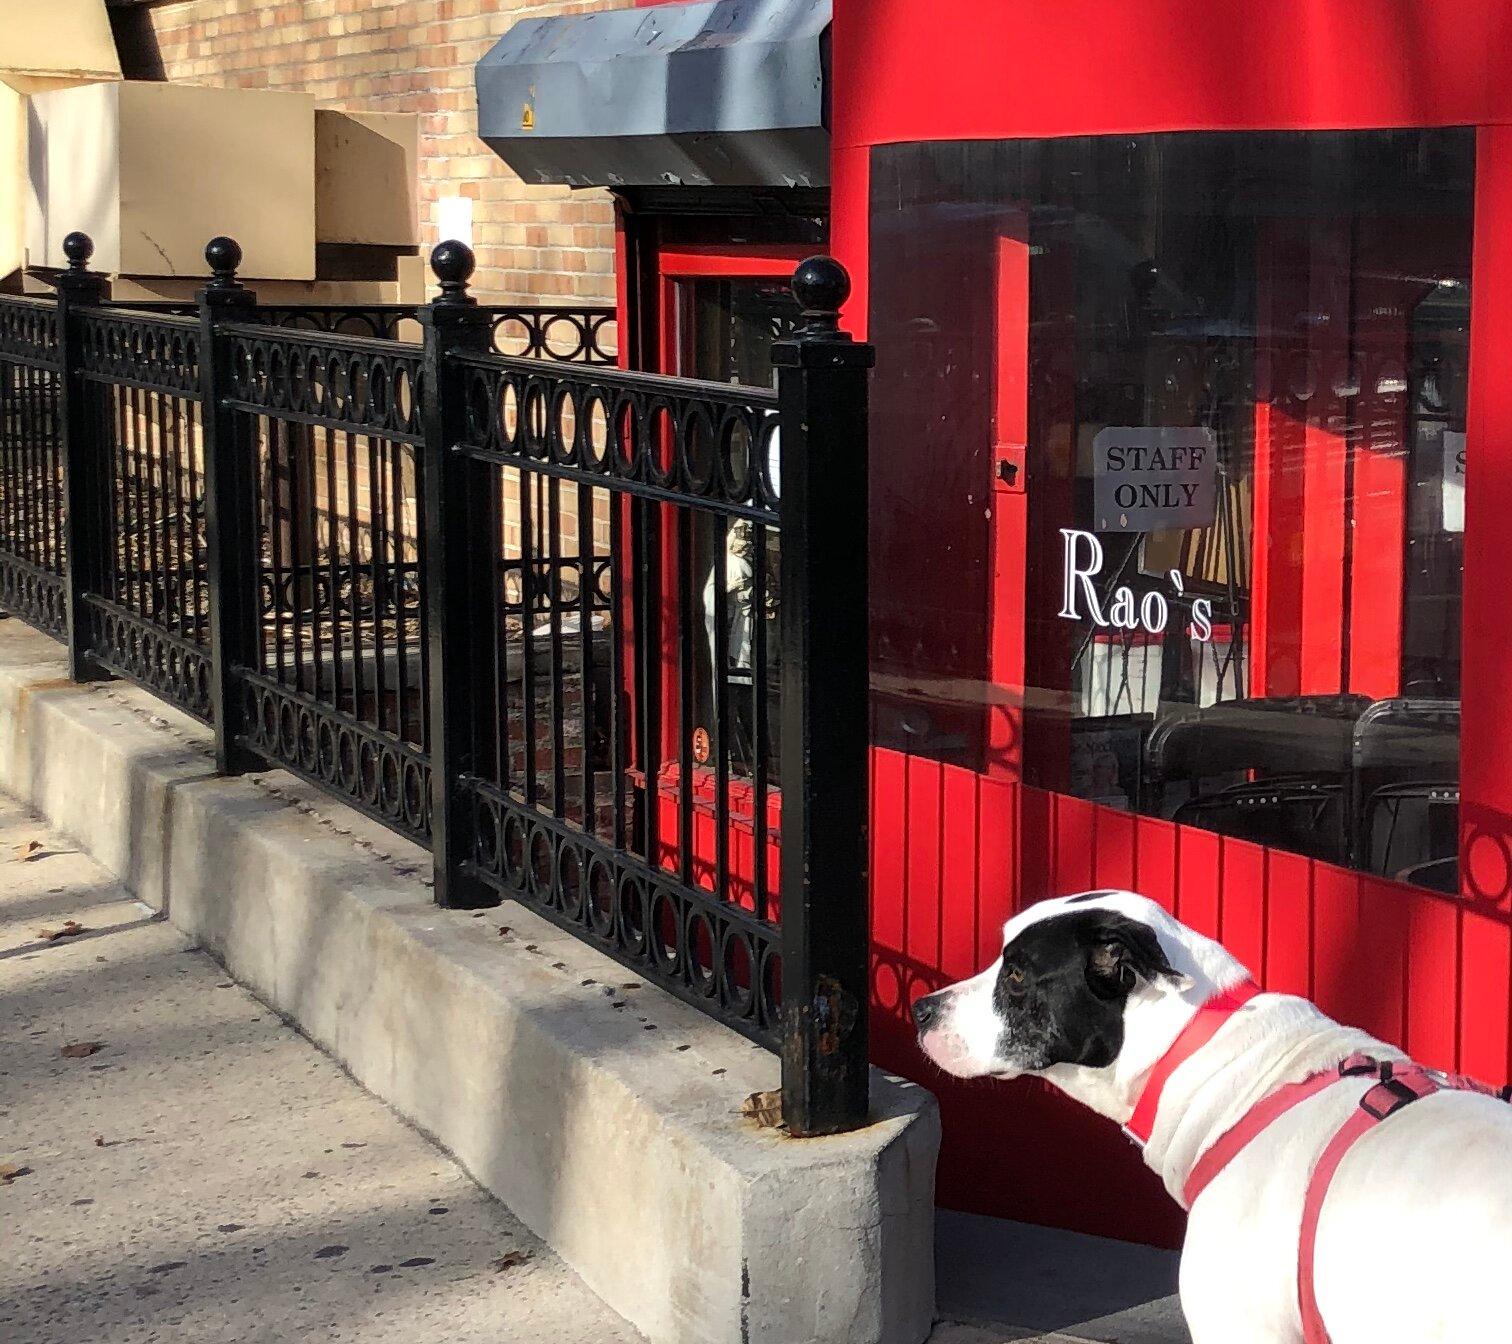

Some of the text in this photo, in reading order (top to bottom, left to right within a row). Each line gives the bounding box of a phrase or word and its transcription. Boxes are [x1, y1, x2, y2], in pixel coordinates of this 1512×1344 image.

[1106, 446, 1206, 471] STAFF
[1114, 483, 1199, 508] ONLY
[1058, 528, 1212, 641] Rao's
